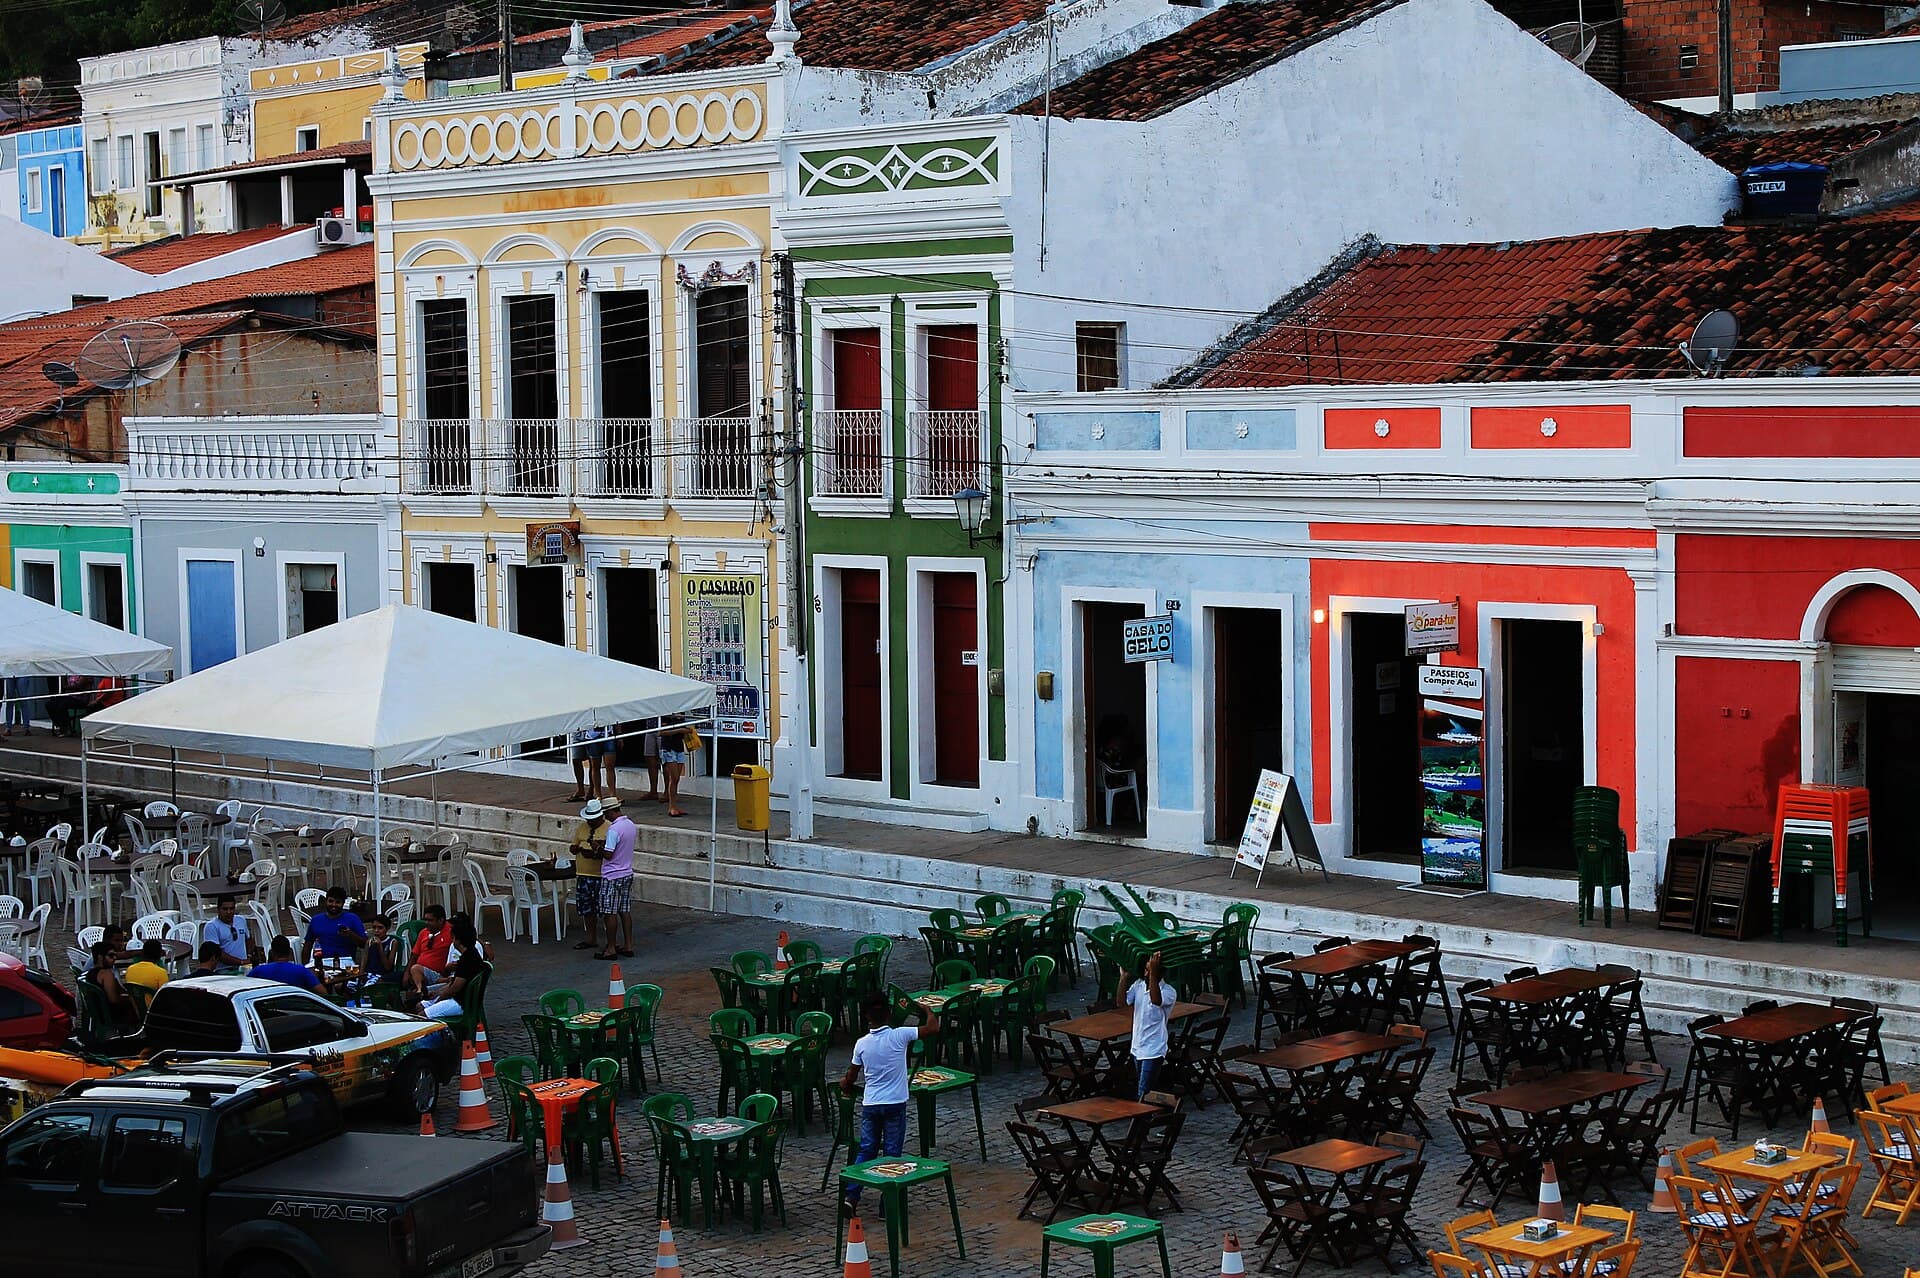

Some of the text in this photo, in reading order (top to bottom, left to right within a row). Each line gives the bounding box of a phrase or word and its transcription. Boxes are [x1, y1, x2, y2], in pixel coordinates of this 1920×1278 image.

[687, 577, 754, 595] O CASARÃO
[1167, 600, 1178, 609] 24
[1125, 623, 1171, 638] CASA DO
[1126, 636, 1170, 655] GELO
[1430, 669, 1470, 679] PASSEIOS
[1424, 676, 1477, 689] Compre Aqui
[267, 1201, 387, 1224] ATTACK
